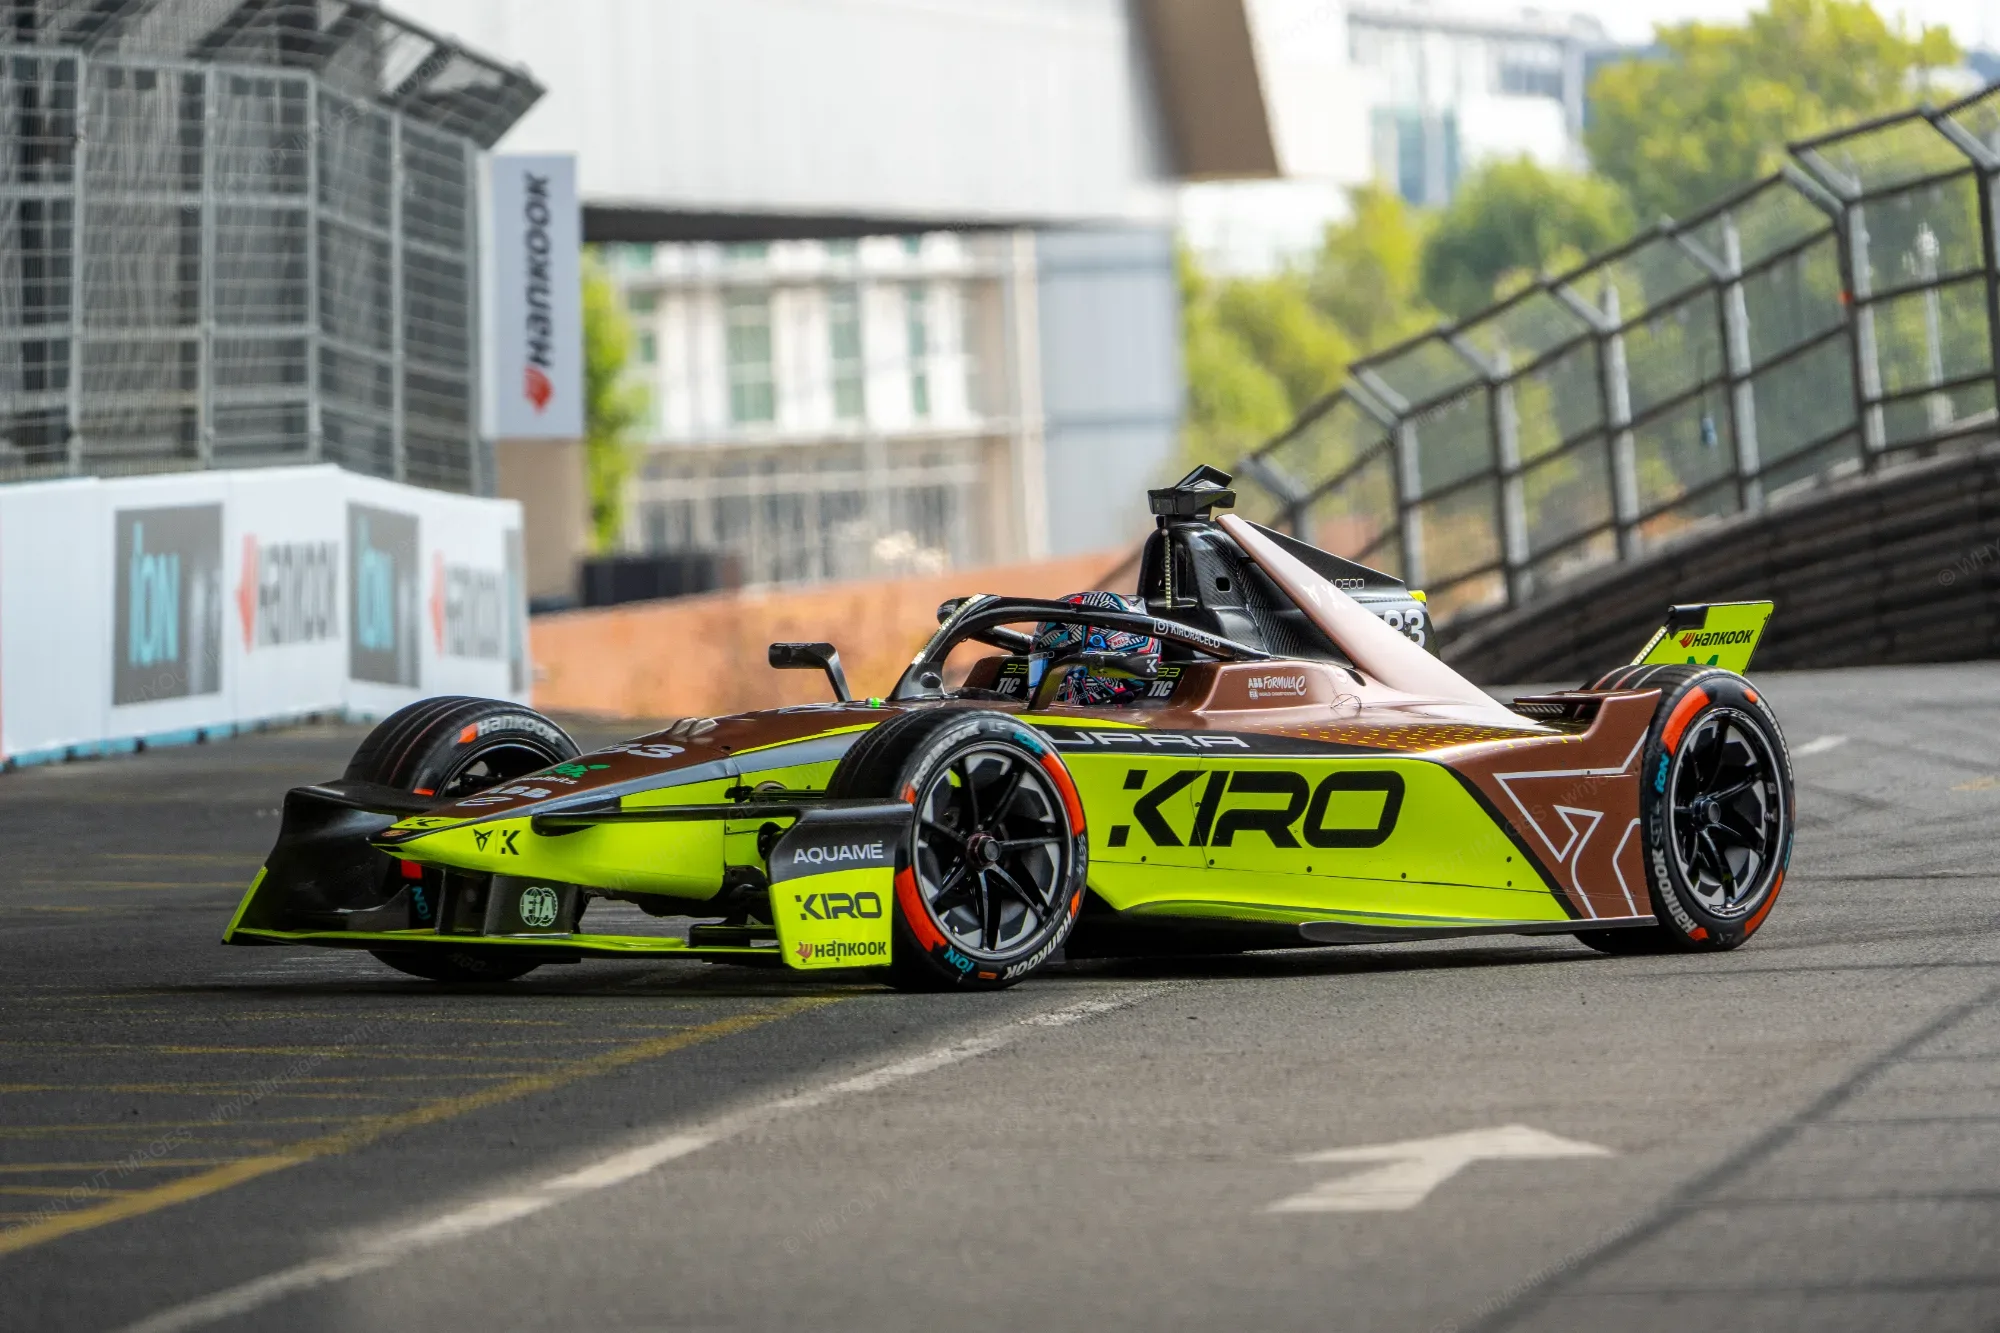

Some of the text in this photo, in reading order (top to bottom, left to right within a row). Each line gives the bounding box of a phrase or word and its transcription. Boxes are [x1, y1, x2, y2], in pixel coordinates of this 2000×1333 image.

[1170, 624, 1221, 649] KIRORACECO
[1003, 664, 1028, 674] 33
[1158, 667, 1180, 678] 33
[996, 677, 1020, 694] TIC
[1147, 680, 1174, 697] TIC
[1248, 678, 1263, 688] ABB
[1036, 730, 1250, 748] UPRA
[1108, 769, 1406, 849] KIRO
[795, 891, 882, 920] KIRO
